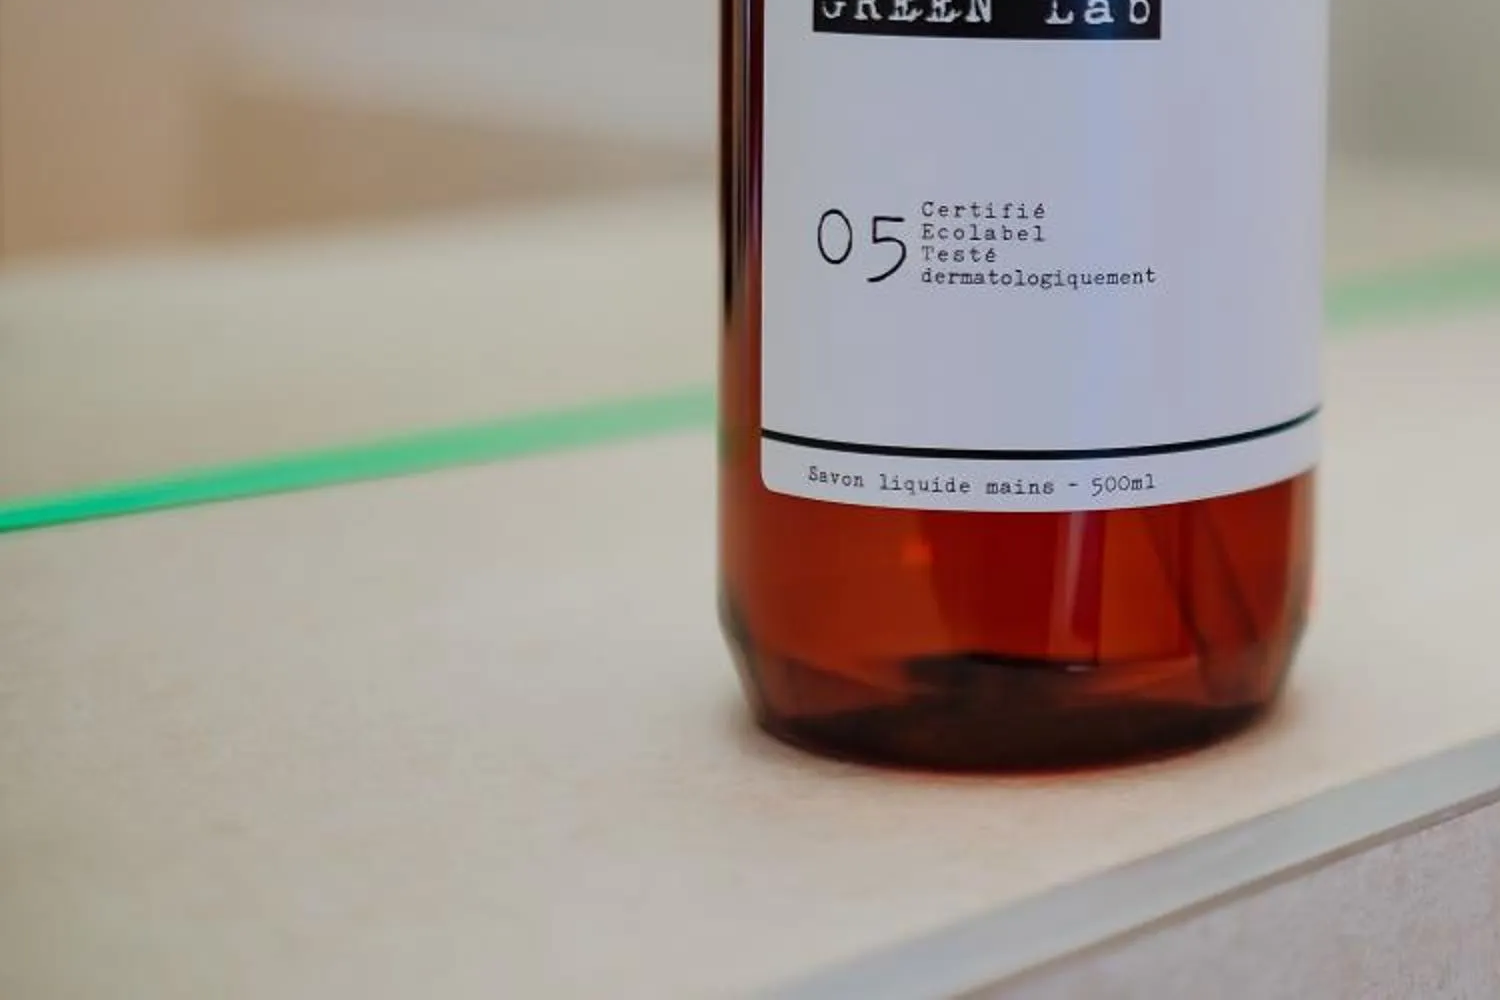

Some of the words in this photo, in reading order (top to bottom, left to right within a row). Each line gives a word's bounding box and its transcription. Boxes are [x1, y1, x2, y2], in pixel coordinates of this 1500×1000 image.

[920, 200, 1047, 220] Certifié
[920, 223, 1047, 242] Ecolabel
[816, 207, 908, 284] 05
[920, 246, 998, 264] Testé
[920, 267, 1157, 290] dermatologiquement
[807, 465, 865, 489] Savon
[878, 473, 972, 496] liquide
[985, 476, 1055, 496] mains
[1090, 472, 1157, 498] 500ml
